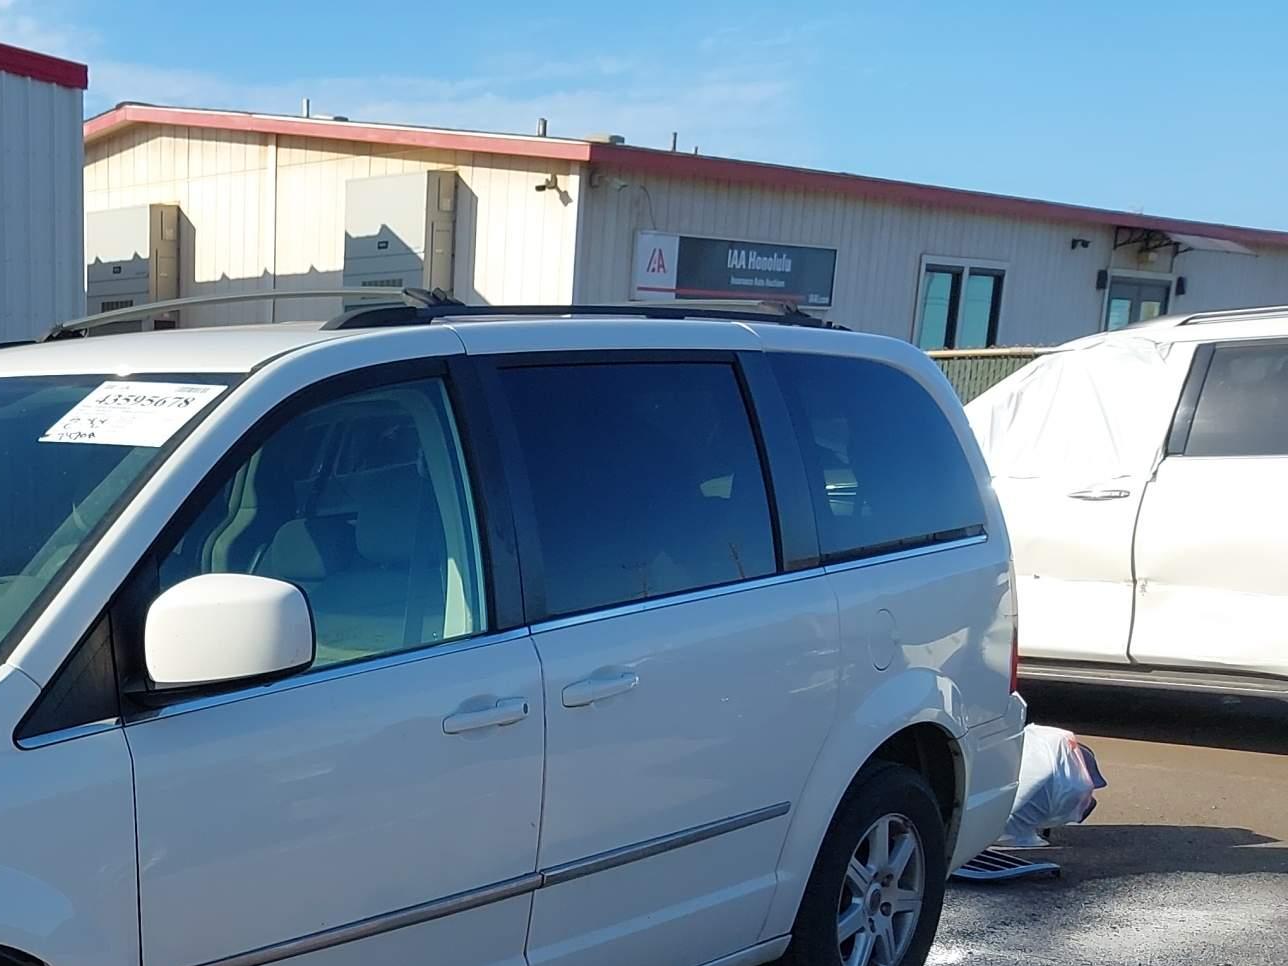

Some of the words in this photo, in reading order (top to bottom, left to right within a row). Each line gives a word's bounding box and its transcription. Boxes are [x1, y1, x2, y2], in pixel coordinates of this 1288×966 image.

[727, 248, 746, 269] IAA
[748, 250, 792, 273] Honolulu
[95, 393, 196, 409] 43595678
